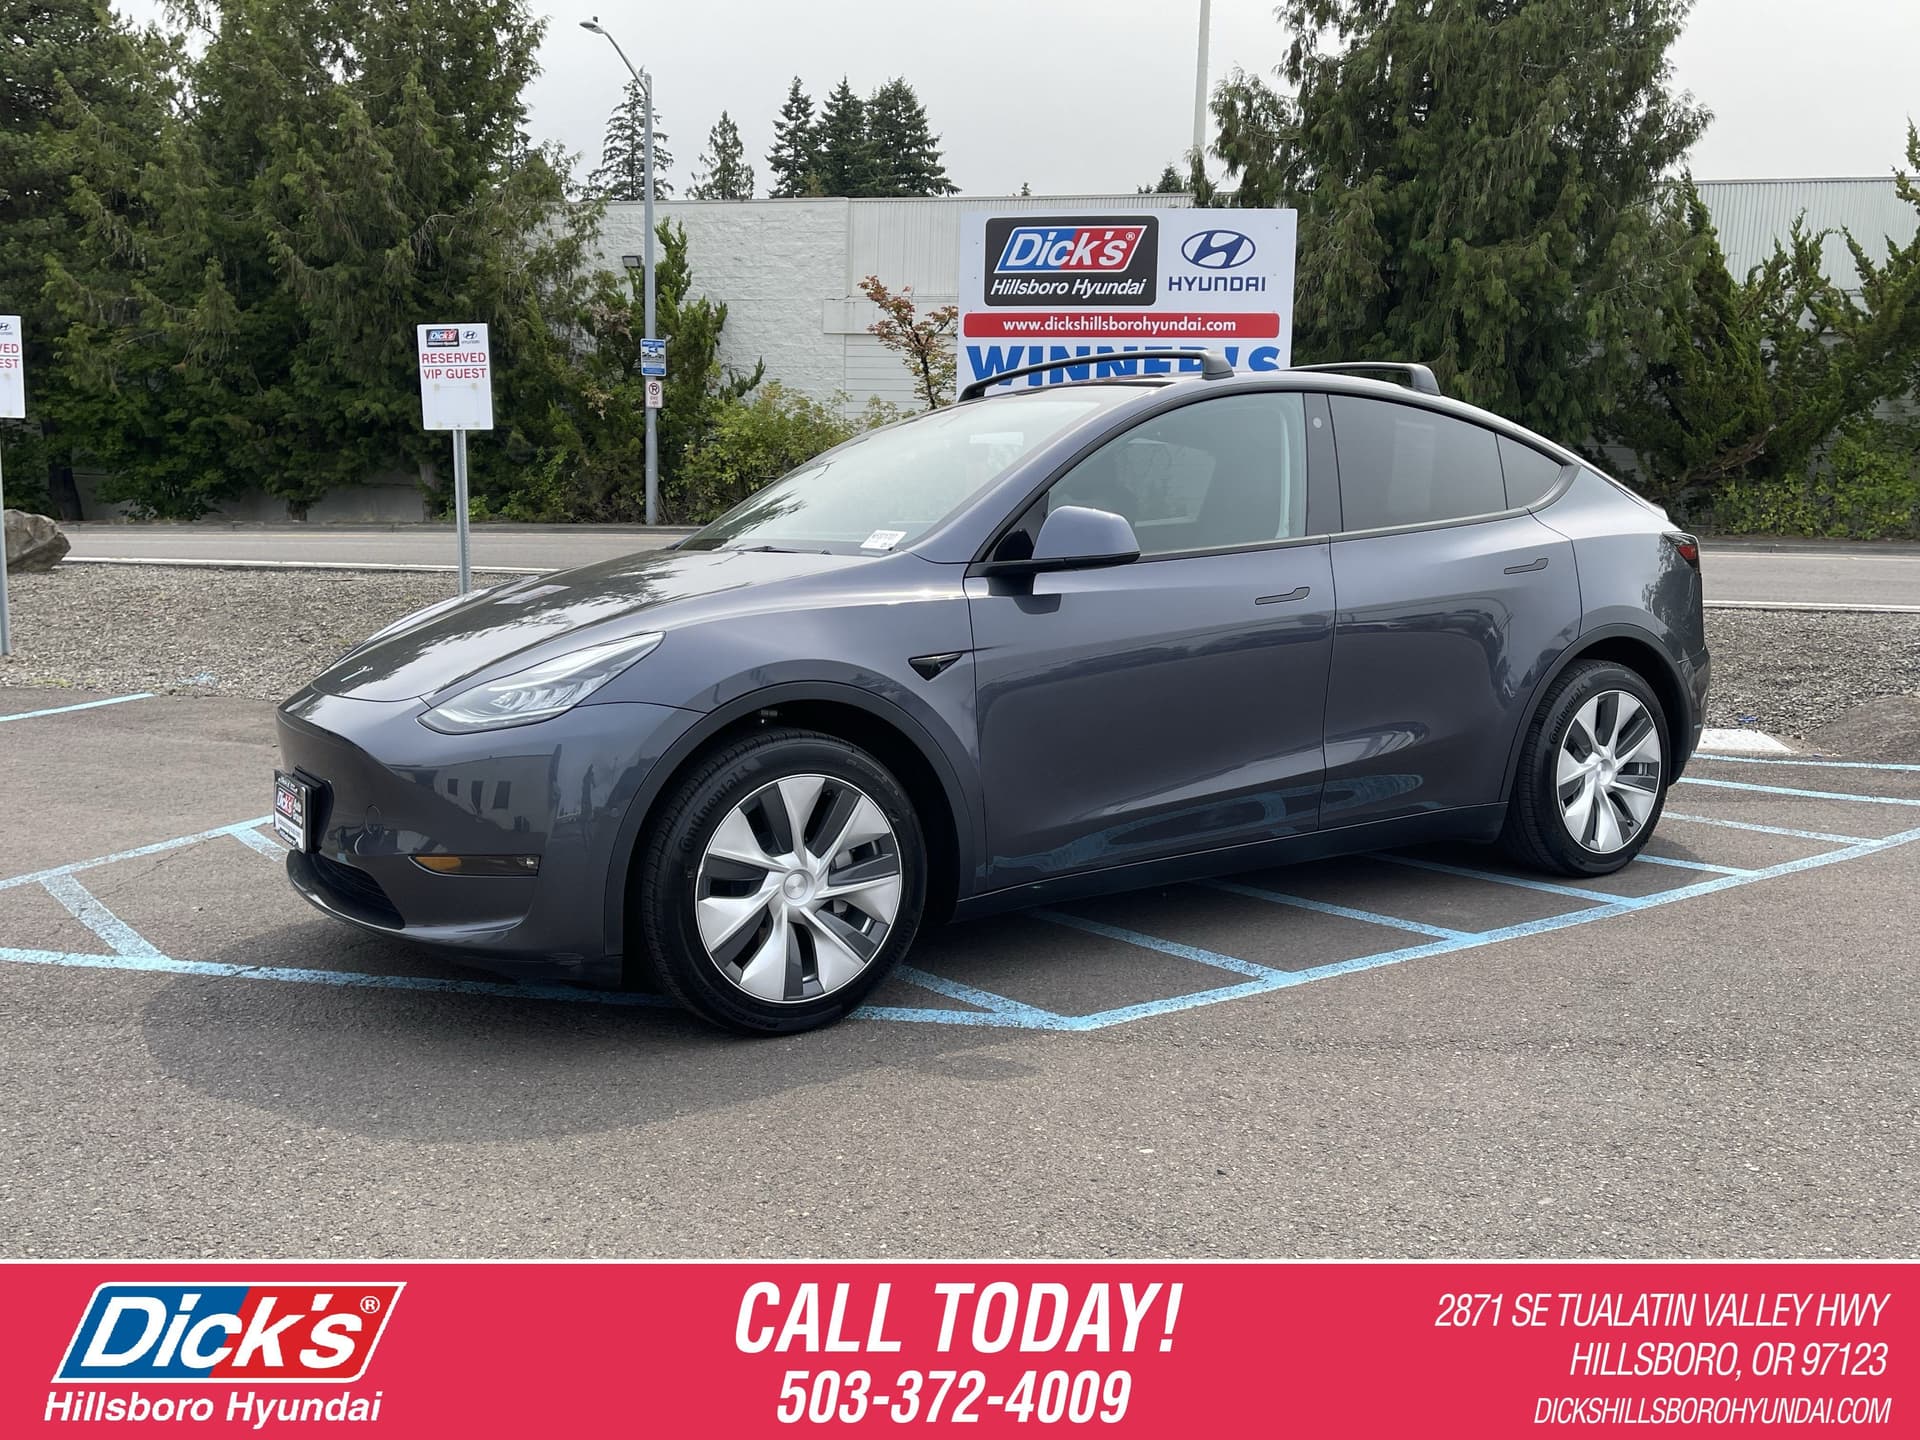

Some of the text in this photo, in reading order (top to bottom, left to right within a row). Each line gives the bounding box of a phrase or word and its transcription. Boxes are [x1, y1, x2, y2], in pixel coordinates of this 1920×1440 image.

[990, 278, 1147, 299] Hillsboro Hyundai
[1168, 276, 1265, 292] HYUNDAI
[1003, 315, 1237, 335] www.dickshillsborohyundai.com
[421, 352, 486, 363] RESERVED
[423, 368, 486, 379] VIP GUEST
